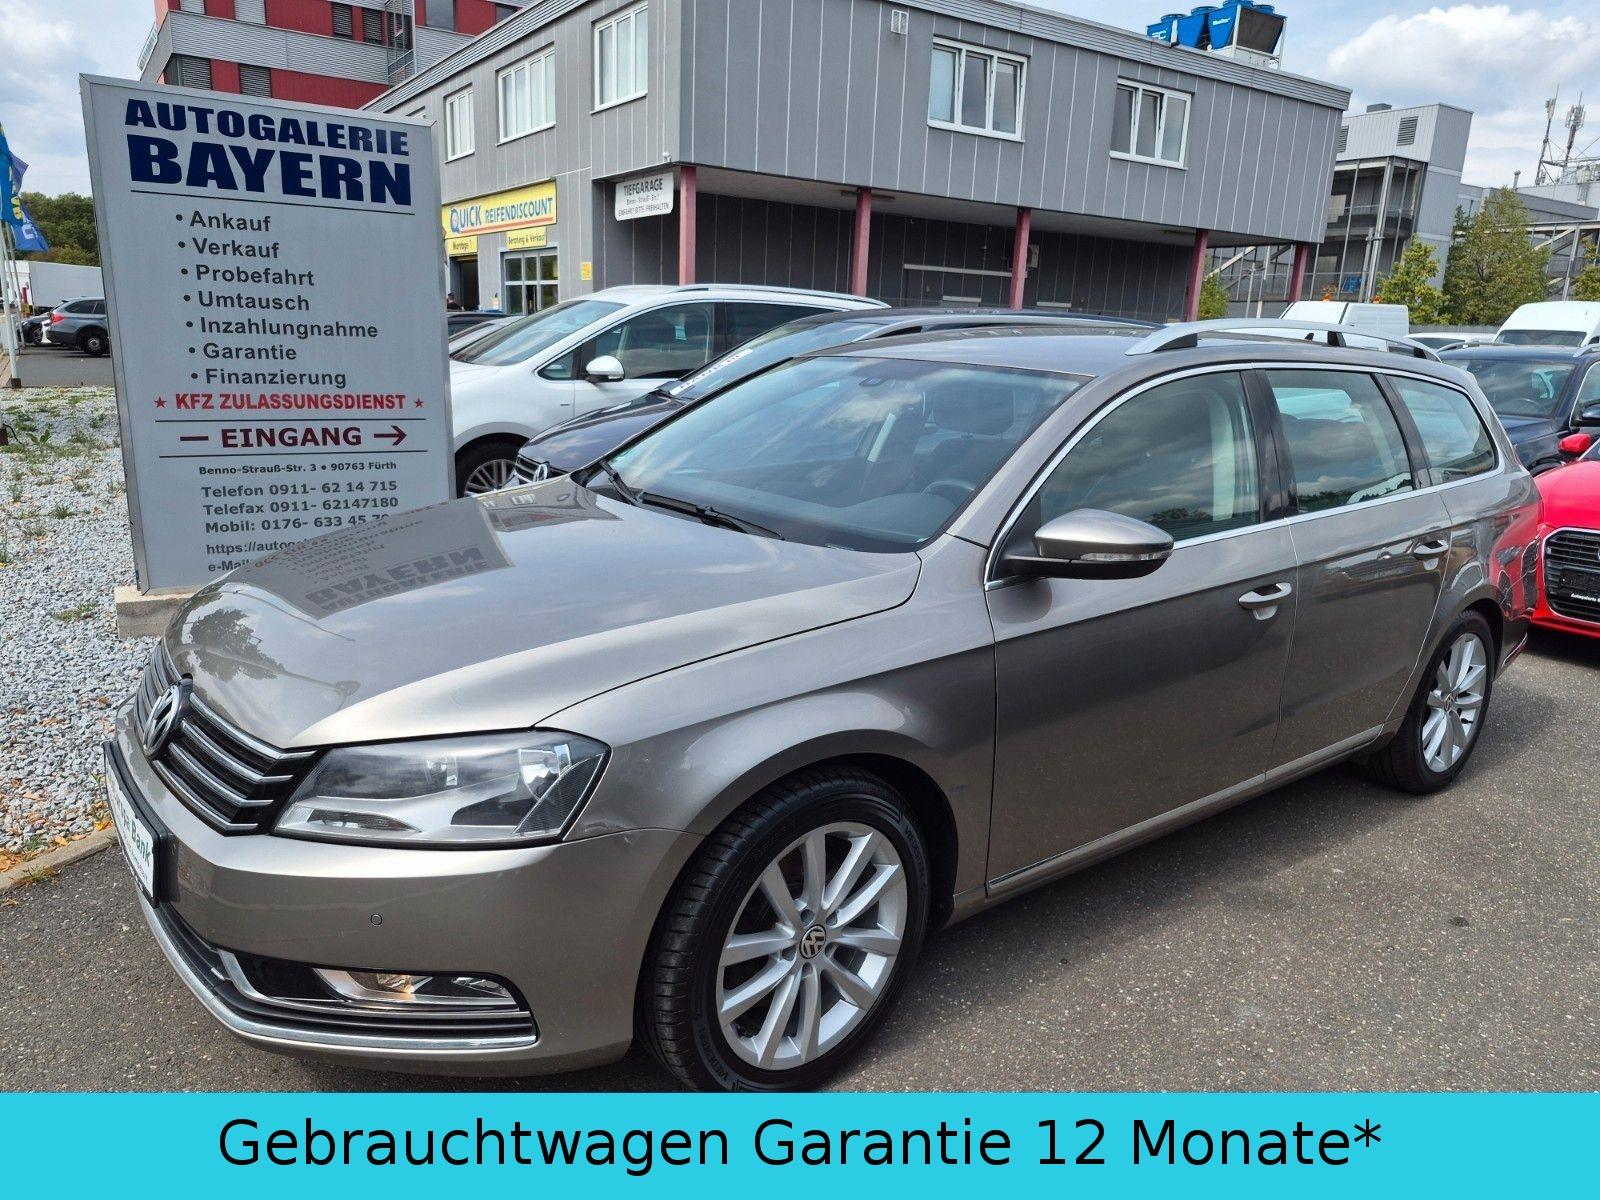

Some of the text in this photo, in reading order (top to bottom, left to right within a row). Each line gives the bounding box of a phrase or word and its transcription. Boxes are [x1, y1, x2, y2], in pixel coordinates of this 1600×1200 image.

[125, 98, 409, 156] AUTOGALERIE
[127, 134, 411, 206] BAYERN
[623, 178, 663, 196] TIEFGARAGE
[190, 211, 270, 231] Ankauf
[450, 198, 553, 234] QUICK REIFENDISCOUNT
[192, 237, 279, 258] Verkauf
[196, 264, 314, 287] Probefahrt
[198, 291, 309, 311] Umtausch
[201, 317, 377, 339] Inzahlungnahme
[203, 343, 296, 361] Garantie
[206, 368, 347, 389] Finanzierung
[176, 394, 406, 410] KFZ ZULASSUNGSDIENST
[222, 427, 362, 448] EINGANG
[199, 461, 396, 475] Benno-Strauß-Str. 3 90763 Fürth
[201, 481, 397, 498] Telefon 0911- 62 14 715
[203, 503, 265, 516] Telefax
[270, 501, 317, 513] 0911-
[323, 497, 398, 511] 62147180
[206, 520, 255, 533] Mobil:
[262, 518, 308, 530] 0176-
[314, 516, 342, 527] 633
[348, 515, 366, 526] 45
